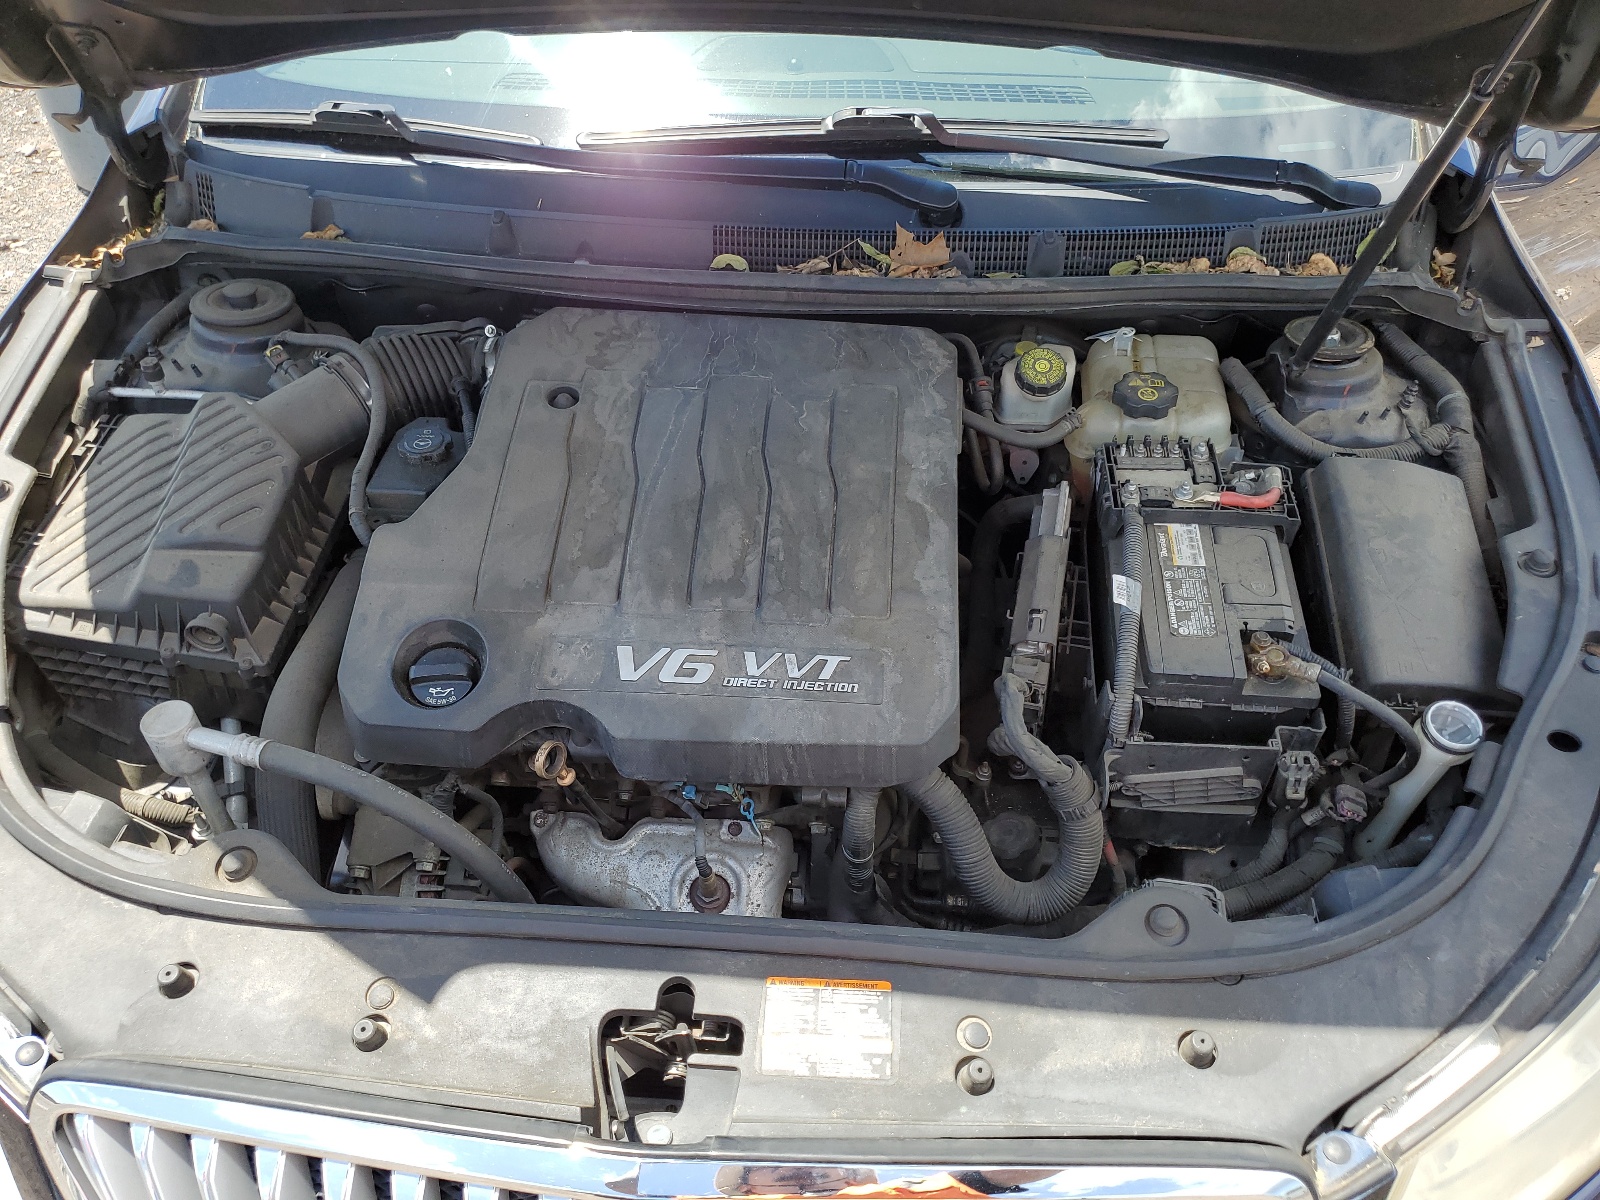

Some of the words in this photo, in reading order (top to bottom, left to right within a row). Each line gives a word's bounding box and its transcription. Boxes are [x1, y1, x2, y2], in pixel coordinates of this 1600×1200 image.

[617, 645, 719, 684] V6
[744, 651, 852, 681] VVT
[722, 677, 778, 689] DIRECT
[782, 680, 859, 693] INJECTION
[425, 696, 437, 705] SAE
[778, 979, 805, 987] WARNING
[832, 980, 879, 990] AVERTISSEMENT
